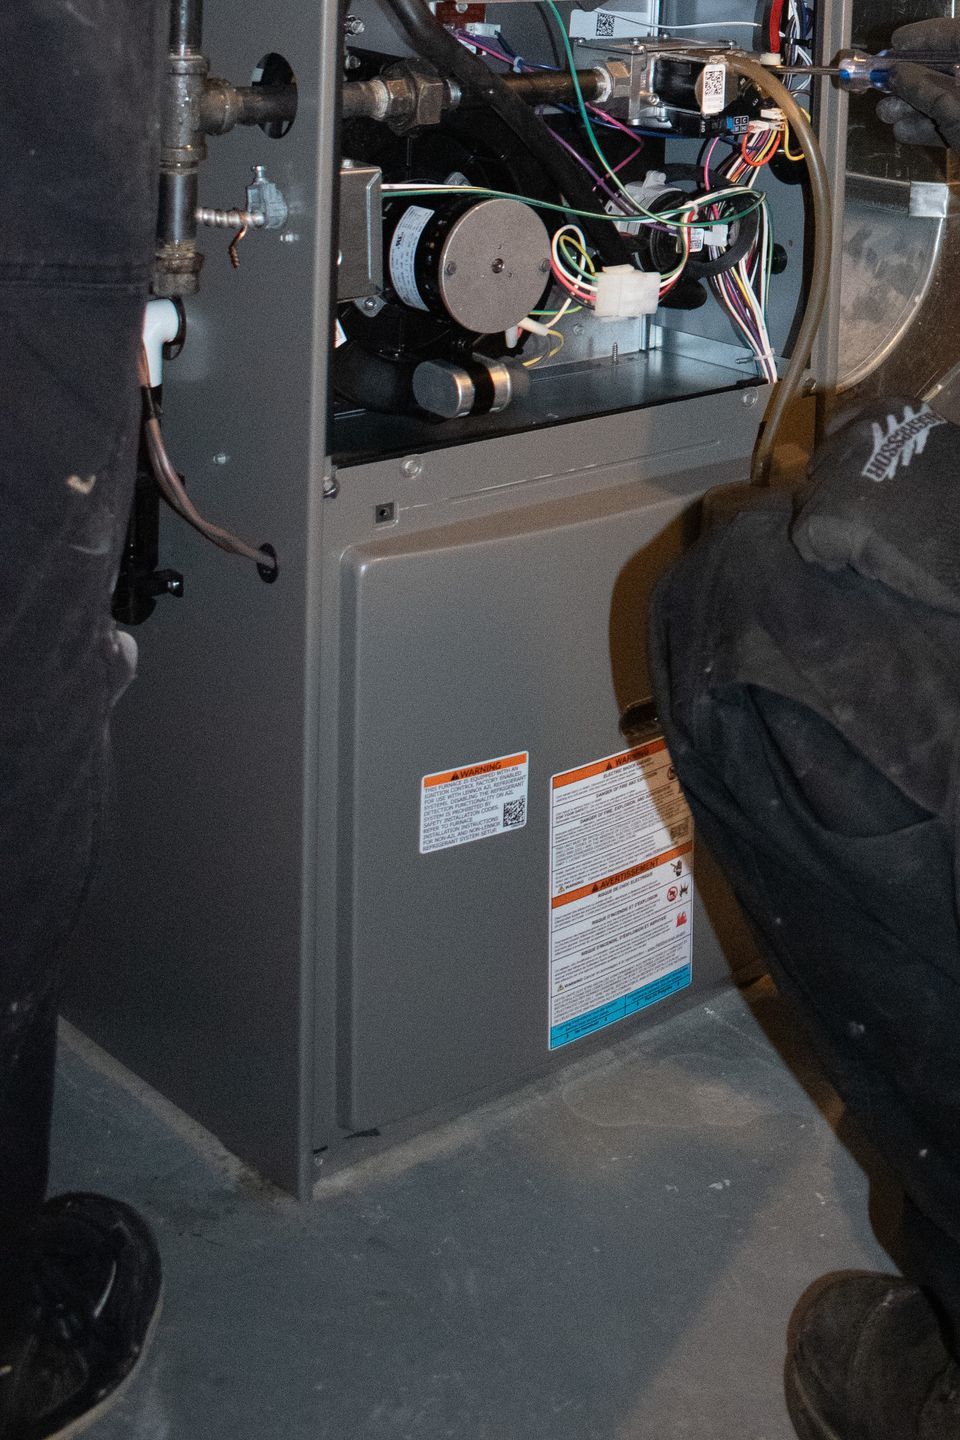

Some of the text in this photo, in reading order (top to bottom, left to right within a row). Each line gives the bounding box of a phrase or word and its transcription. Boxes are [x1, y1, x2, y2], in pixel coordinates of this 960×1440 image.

[460, 762, 501, 777] WARNING
[603, 768, 620, 778] ELECTRIC
[424, 770, 521, 799] IGNITION CONTROL FACTORY ENABLED
[438, 780, 460, 790] FURNACE
[450, 792, 478, 804] DISABLING
[490, 780, 523, 794] REFRIGERANT
[462, 785, 482, 795] LENNOX
[493, 774, 525, 787] REFRIGERANT
[596, 788, 612, 798] DANGER
[424, 804, 453, 816] DETECTION
[454, 794, 494, 808] FUNCTIONALITY
[424, 813, 444, 822] SYSTEM
[452, 802, 483, 815] PROHIBITED
[423, 819, 441, 828] SAFETY
[443, 809, 479, 822] INSTALLATION
[423, 825, 438, 833] REFER
[449, 817, 472, 826] FURNACE
[580, 815, 595, 824] DANGER
[423, 816, 498, 839] INSTALLATION INSTRUCTIONS
[423, 837, 458, 850] REFRIGERANT
[459, 832, 479, 841] SYSTEM
[592, 916, 605, 924] RISQUE
[581, 947, 595, 955] RISQUE
